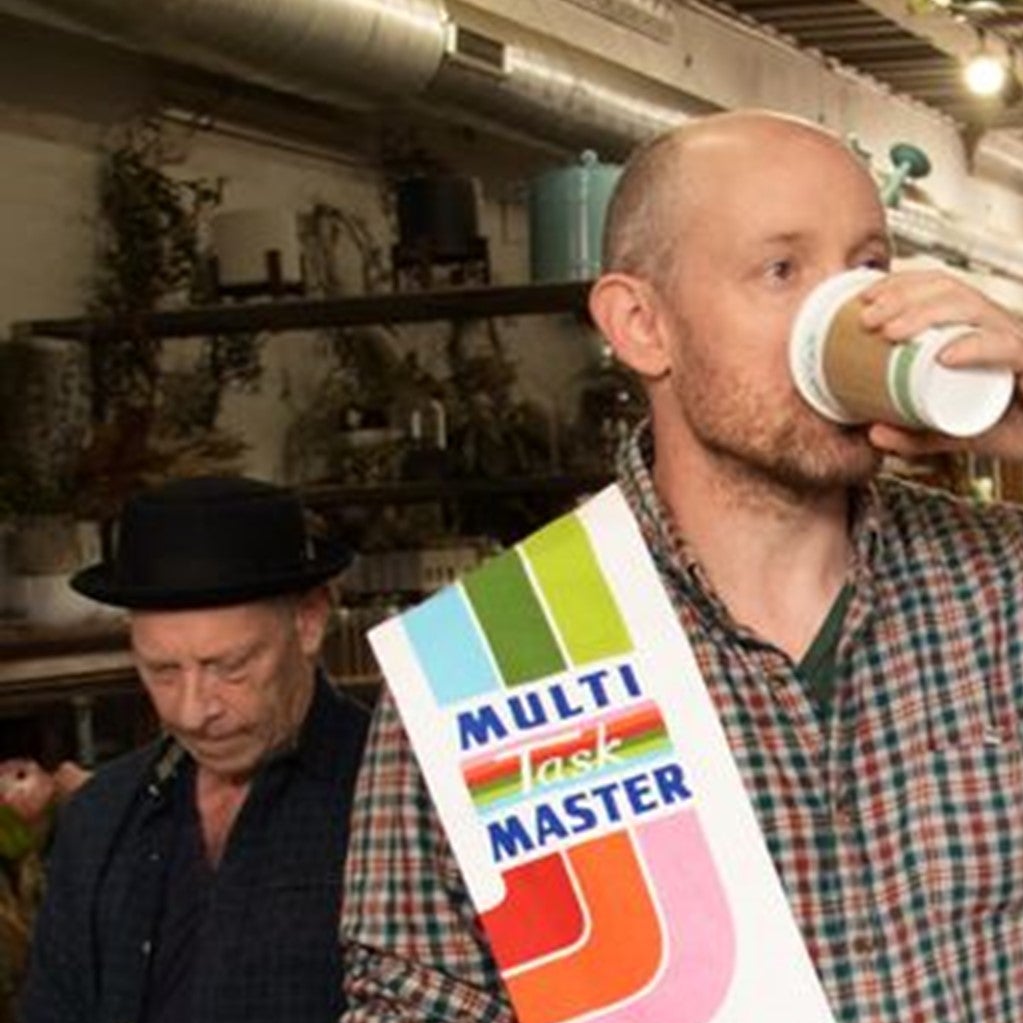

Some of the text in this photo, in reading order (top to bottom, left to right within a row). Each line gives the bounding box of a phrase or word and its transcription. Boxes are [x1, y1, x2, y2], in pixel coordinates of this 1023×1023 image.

[457, 664, 642, 750] MULTI
[492, 721, 623, 794] Task
[487, 763, 693, 863] MASTER
